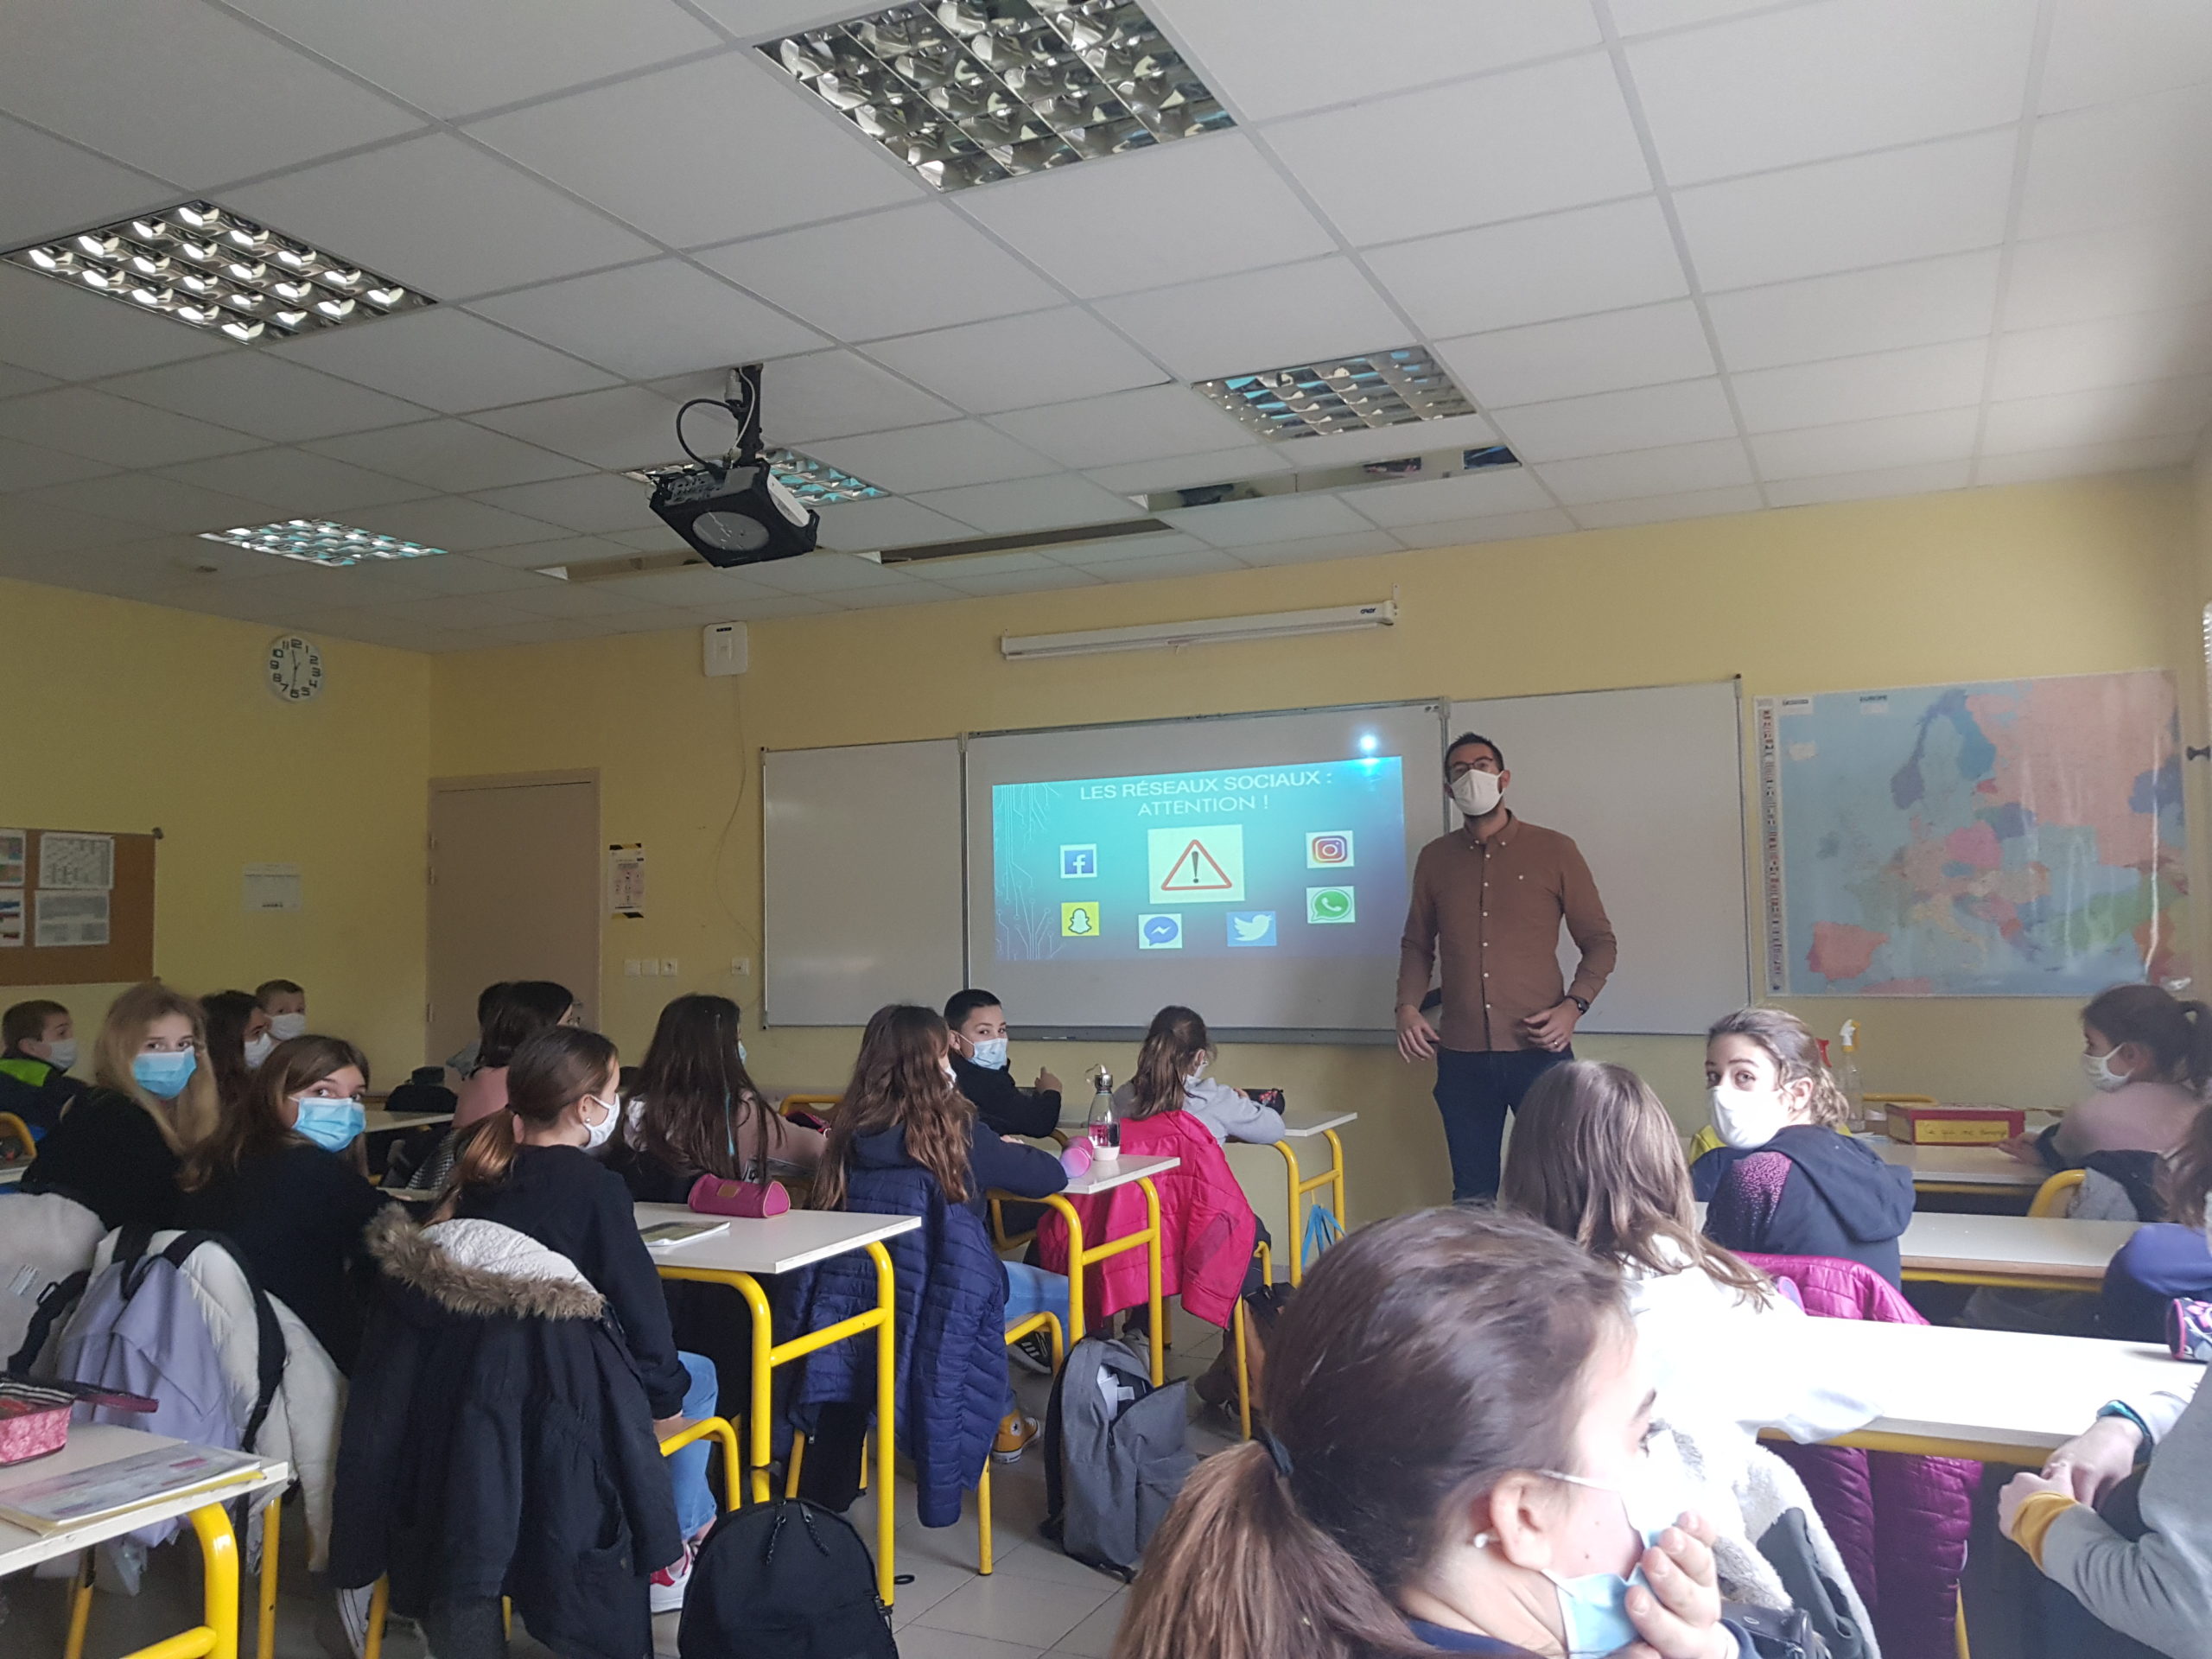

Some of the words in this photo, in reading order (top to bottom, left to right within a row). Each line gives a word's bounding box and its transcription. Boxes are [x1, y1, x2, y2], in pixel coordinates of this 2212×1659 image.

[306, 645, 309, 654] 1
[270, 659, 279, 670] 9
[309, 655, 319, 664] 2
[312, 667, 321, 677] 3
[272, 673, 282, 683] 8
[280, 683, 289, 691] 7
[308, 679, 318, 689] 4
[290, 689, 299, 698] 6
[301, 686, 310, 696] 5
[1080, 785, 1117, 800] LES
[1122, 778, 1219, 798] RÉSEAUX
[1224, 771, 1321, 791] SOCIAUX
[1137, 795, 1255, 817] ATTENTION
[1072, 854, 1086, 874] f
